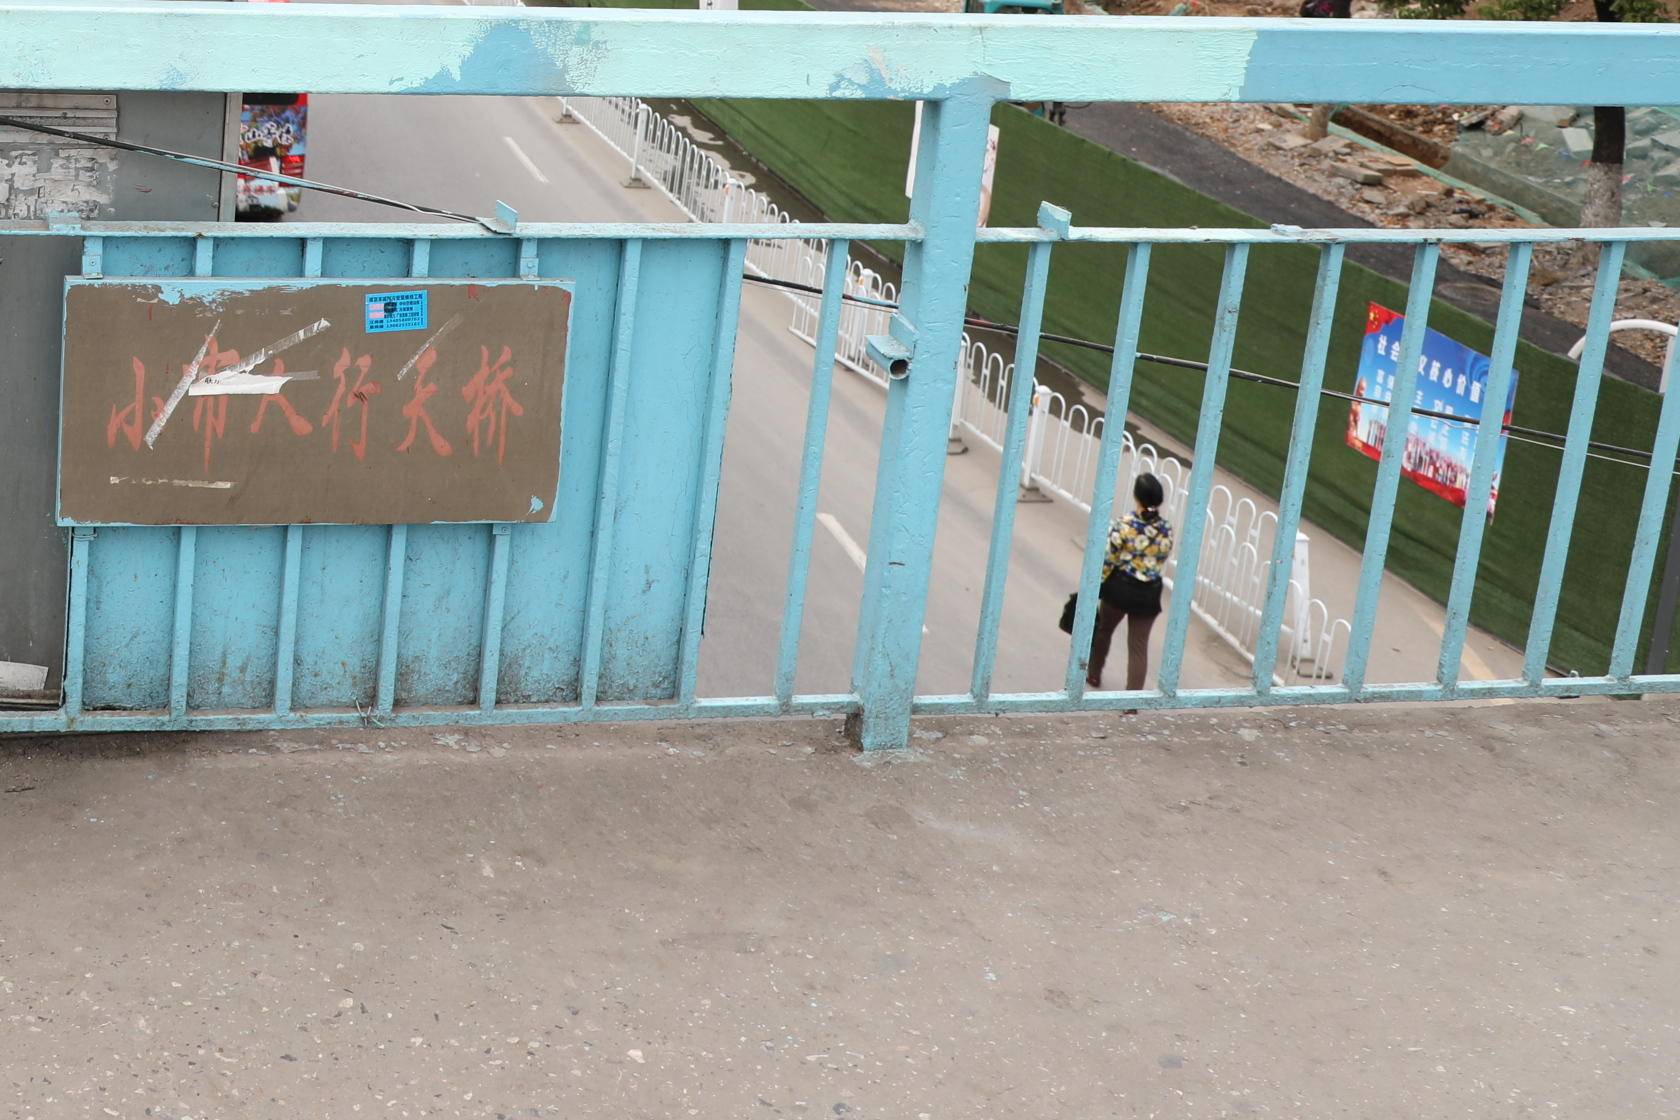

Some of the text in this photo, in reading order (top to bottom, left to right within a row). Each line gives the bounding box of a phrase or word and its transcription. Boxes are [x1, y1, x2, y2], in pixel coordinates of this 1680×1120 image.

[106, 334, 525, 475] 小市人行天桥
